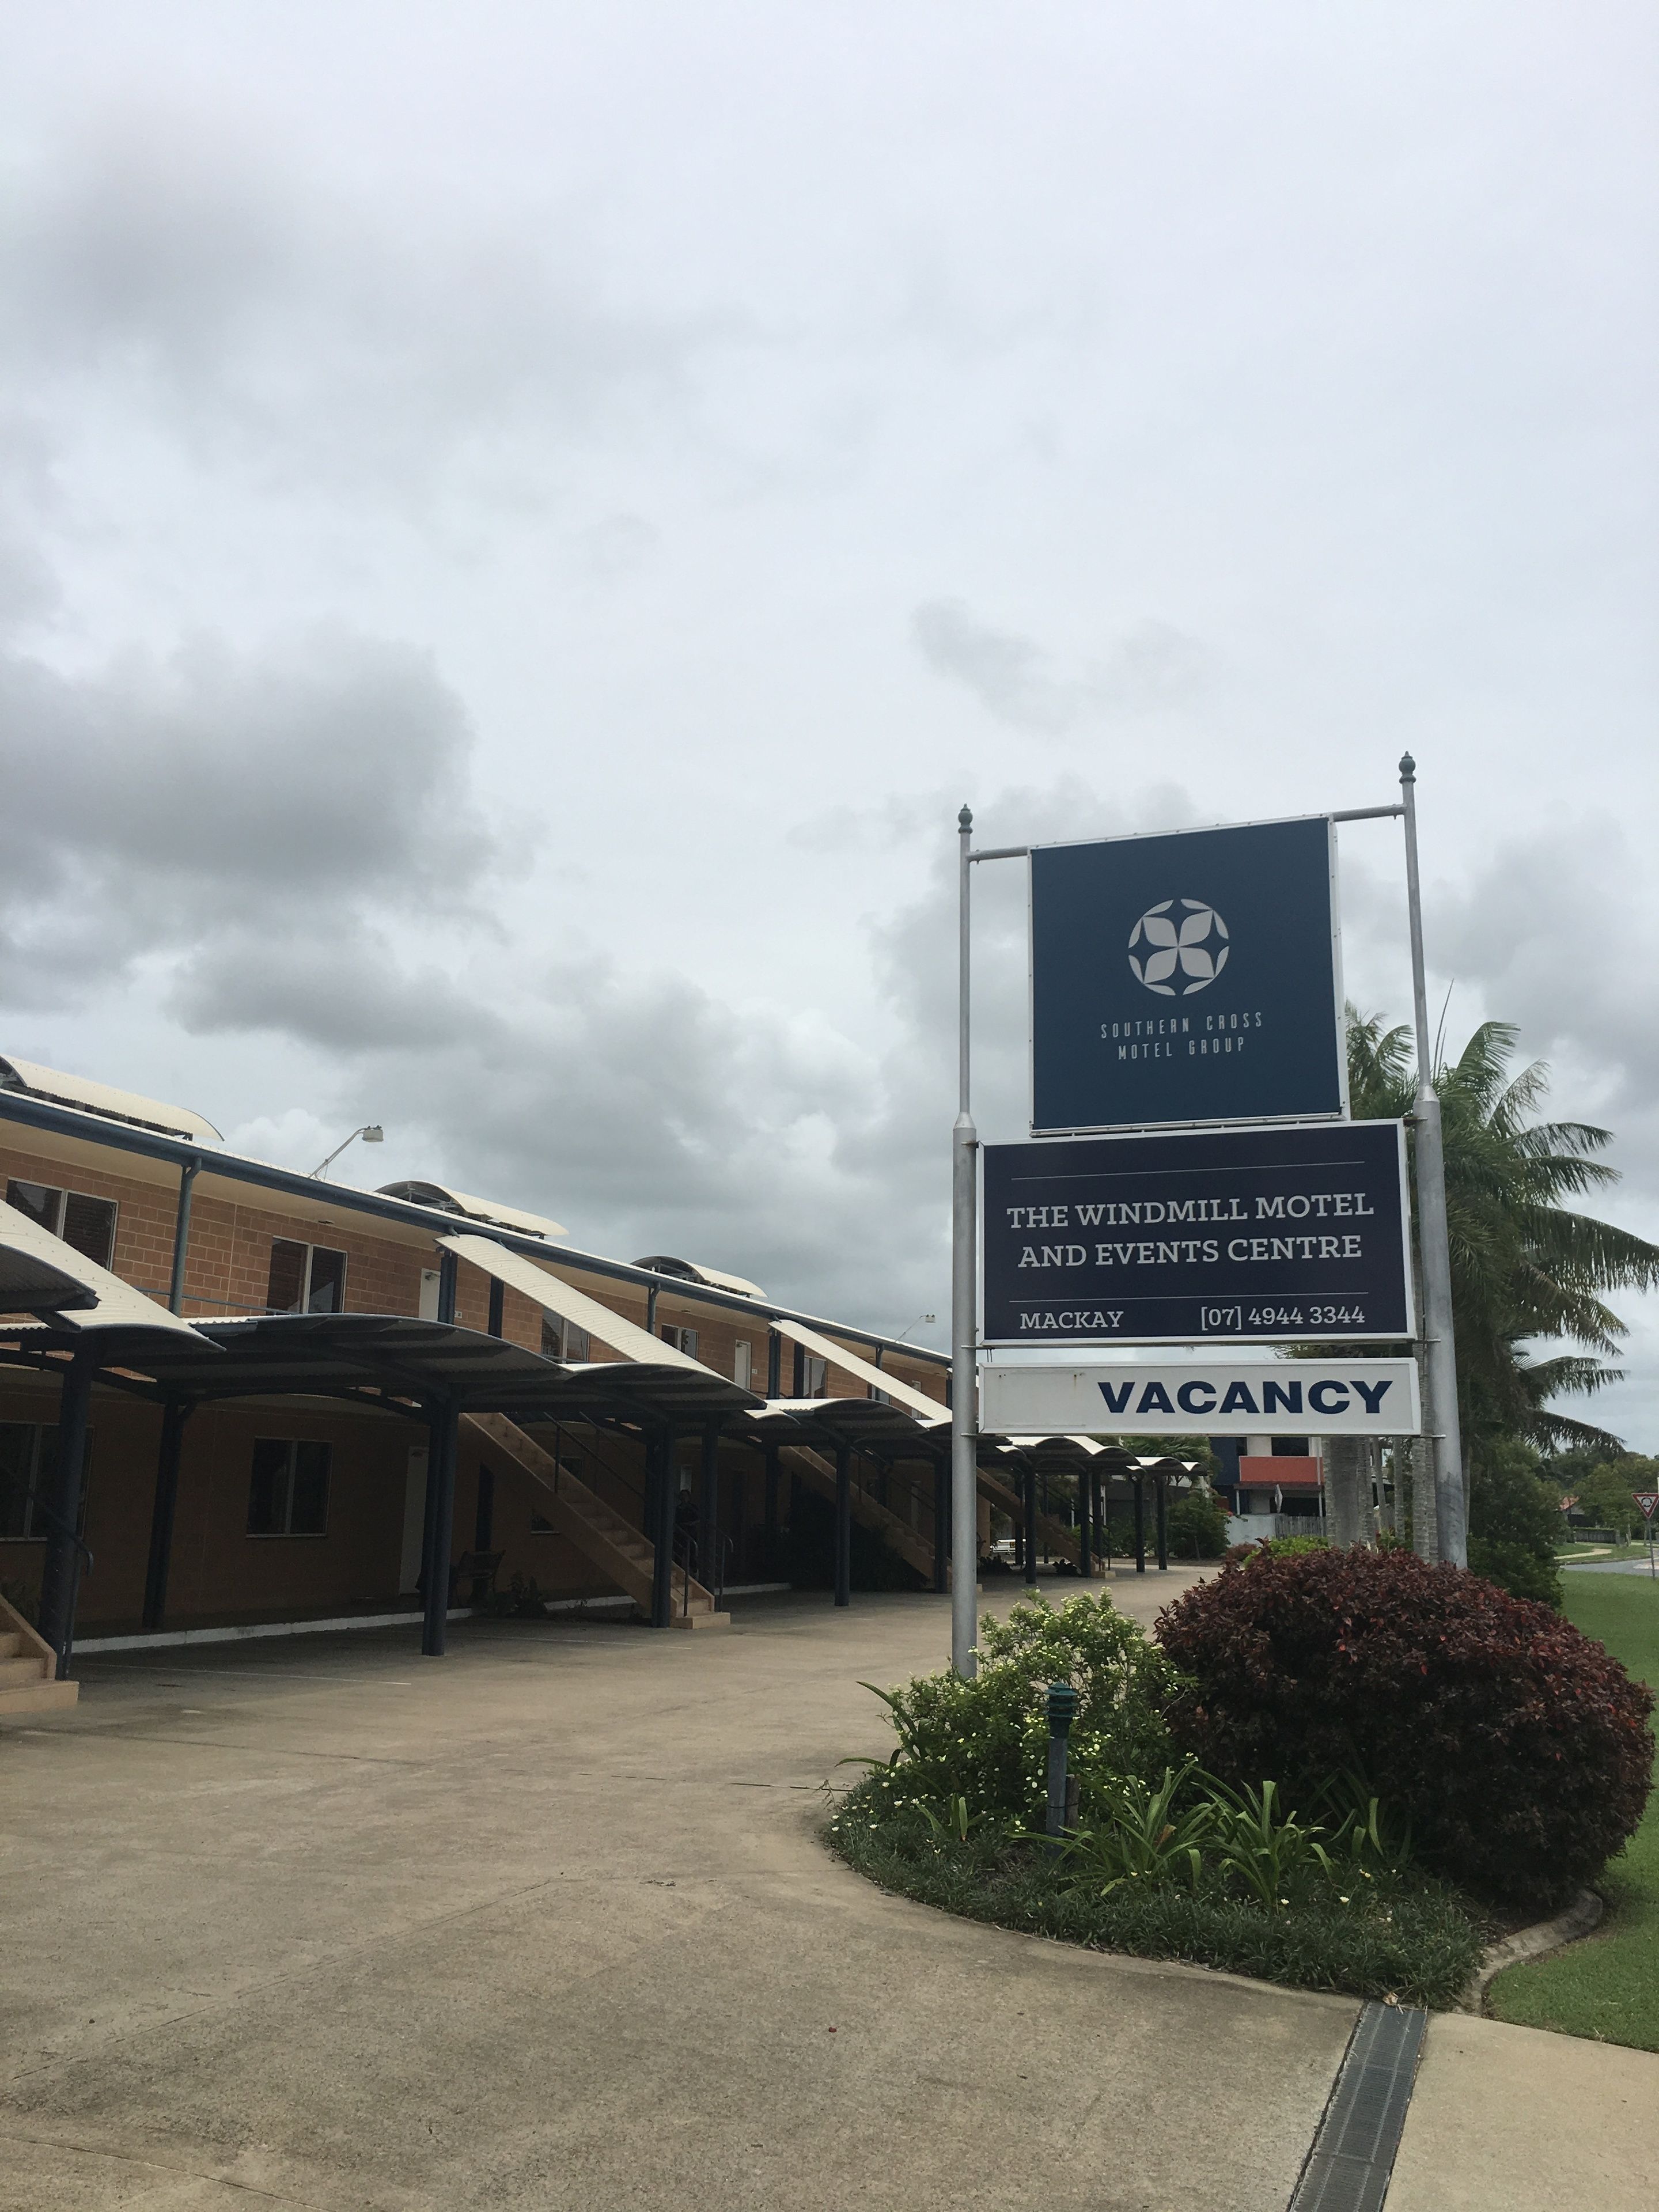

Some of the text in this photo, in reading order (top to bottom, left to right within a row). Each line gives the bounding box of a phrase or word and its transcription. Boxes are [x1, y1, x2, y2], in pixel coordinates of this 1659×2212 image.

[1101, 1012, 1262, 1039] SOUTHERN CROSS
[1118, 1036, 1244, 1060] MOTEL GROUP
[1006, 1192, 1374, 1229] THE WINDMILL MOTEL
[1017, 1235, 1362, 1268] AND EVENTS CENTRE
[1020, 1310, 1124, 1330] MACKAY
[1201, 1305, 1365, 1331] [07] 4944 3344
[1097, 1380, 1393, 1415] VACANCY
